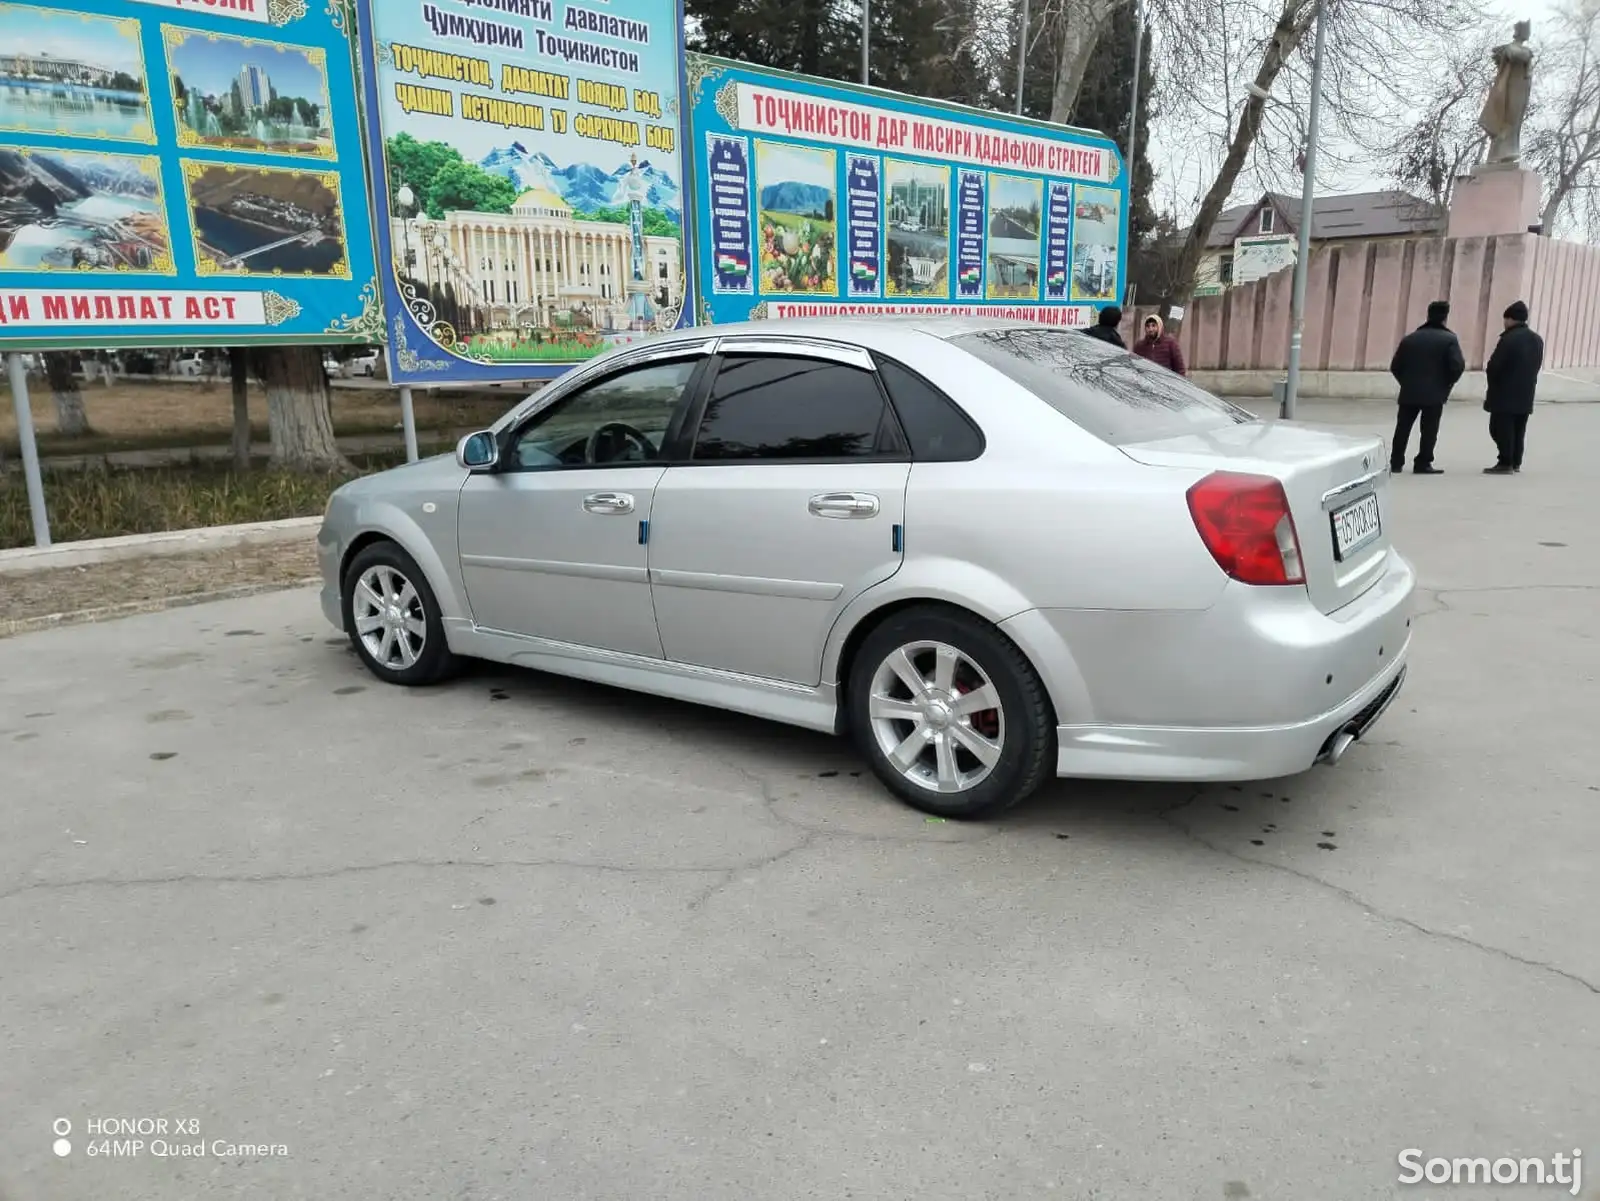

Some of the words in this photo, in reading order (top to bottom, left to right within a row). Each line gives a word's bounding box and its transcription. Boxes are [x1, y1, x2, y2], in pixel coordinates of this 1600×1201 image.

[424, 5, 523, 49] Ҷумҳурии
[536, 30, 638, 72] Тоҷикистон
[565, 7, 648, 43] давлатии
[501, 64, 569, 100] ДАВЛАТАТ
[577, 78, 628, 112] ПОЯНДА
[551, 108, 567, 134] ТУ
[574, 113, 640, 147] ФАРХУНДА
[753, 94, 871, 141] ТОҶИКИСТОН
[877, 115, 908, 148] ДАР
[913, 122, 971, 157] МАСИРИ
[975, 133, 1045, 169] ҲАДАФҲОИ
[41, 295, 173, 320] МИЛЛАТ
[185, 296, 236, 320] АСТ
[1038, 308, 1059, 326] МАН
